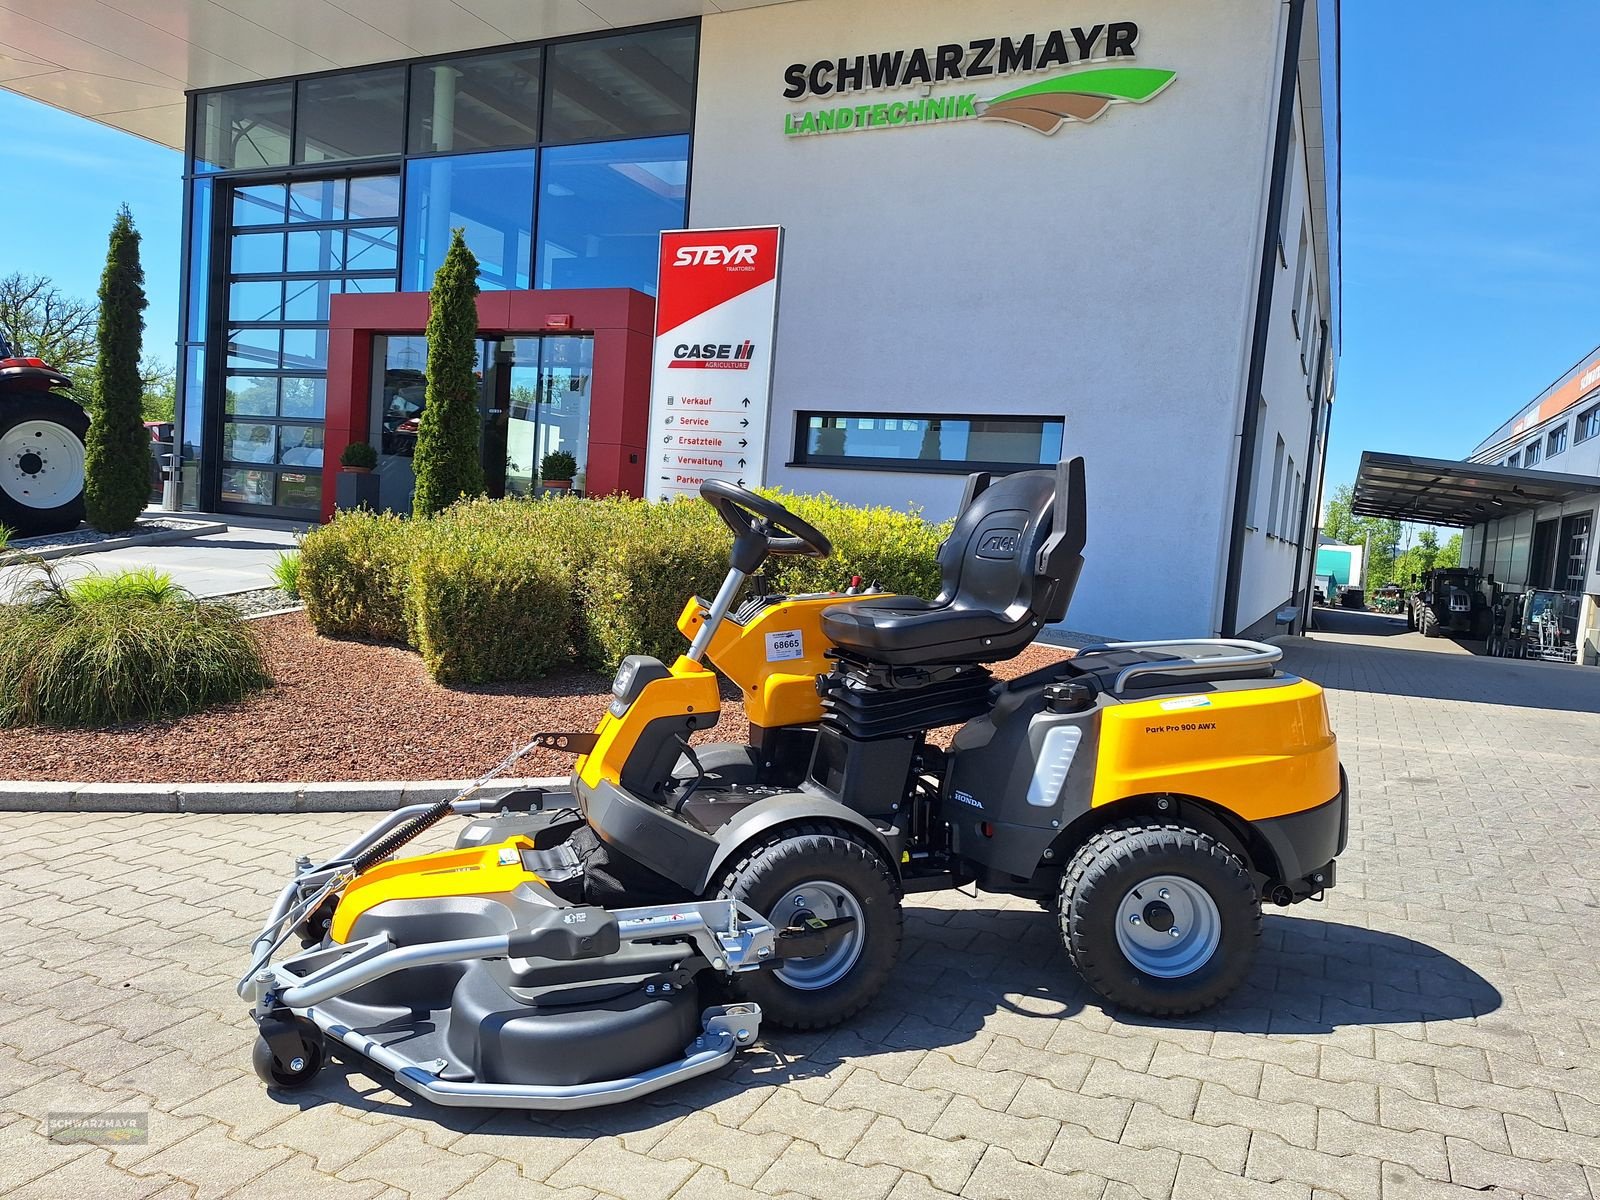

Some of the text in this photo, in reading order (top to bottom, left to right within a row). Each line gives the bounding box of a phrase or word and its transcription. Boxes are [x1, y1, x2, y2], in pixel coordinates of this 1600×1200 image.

[782, 20, 1140, 99] SCHWARZMAYR
[783, 93, 978, 136] LANDTECHNIK
[672, 244, 758, 267] STEYR
[673, 343, 732, 360] CASE
[704, 361, 748, 369] AGRICULTURE
[681, 396, 713, 406] Verkauf
[680, 416, 709, 426] Service
[678, 436, 723, 447] Ersatzteile
[677, 456, 723, 468] Verwaltung
[676, 475, 704, 485] Parken
[773, 639, 800, 650] 68665
[1181, 723, 1196, 731] 900
[1197, 722, 1217, 730] AWX
[954, 793, 985, 810] HONDA
